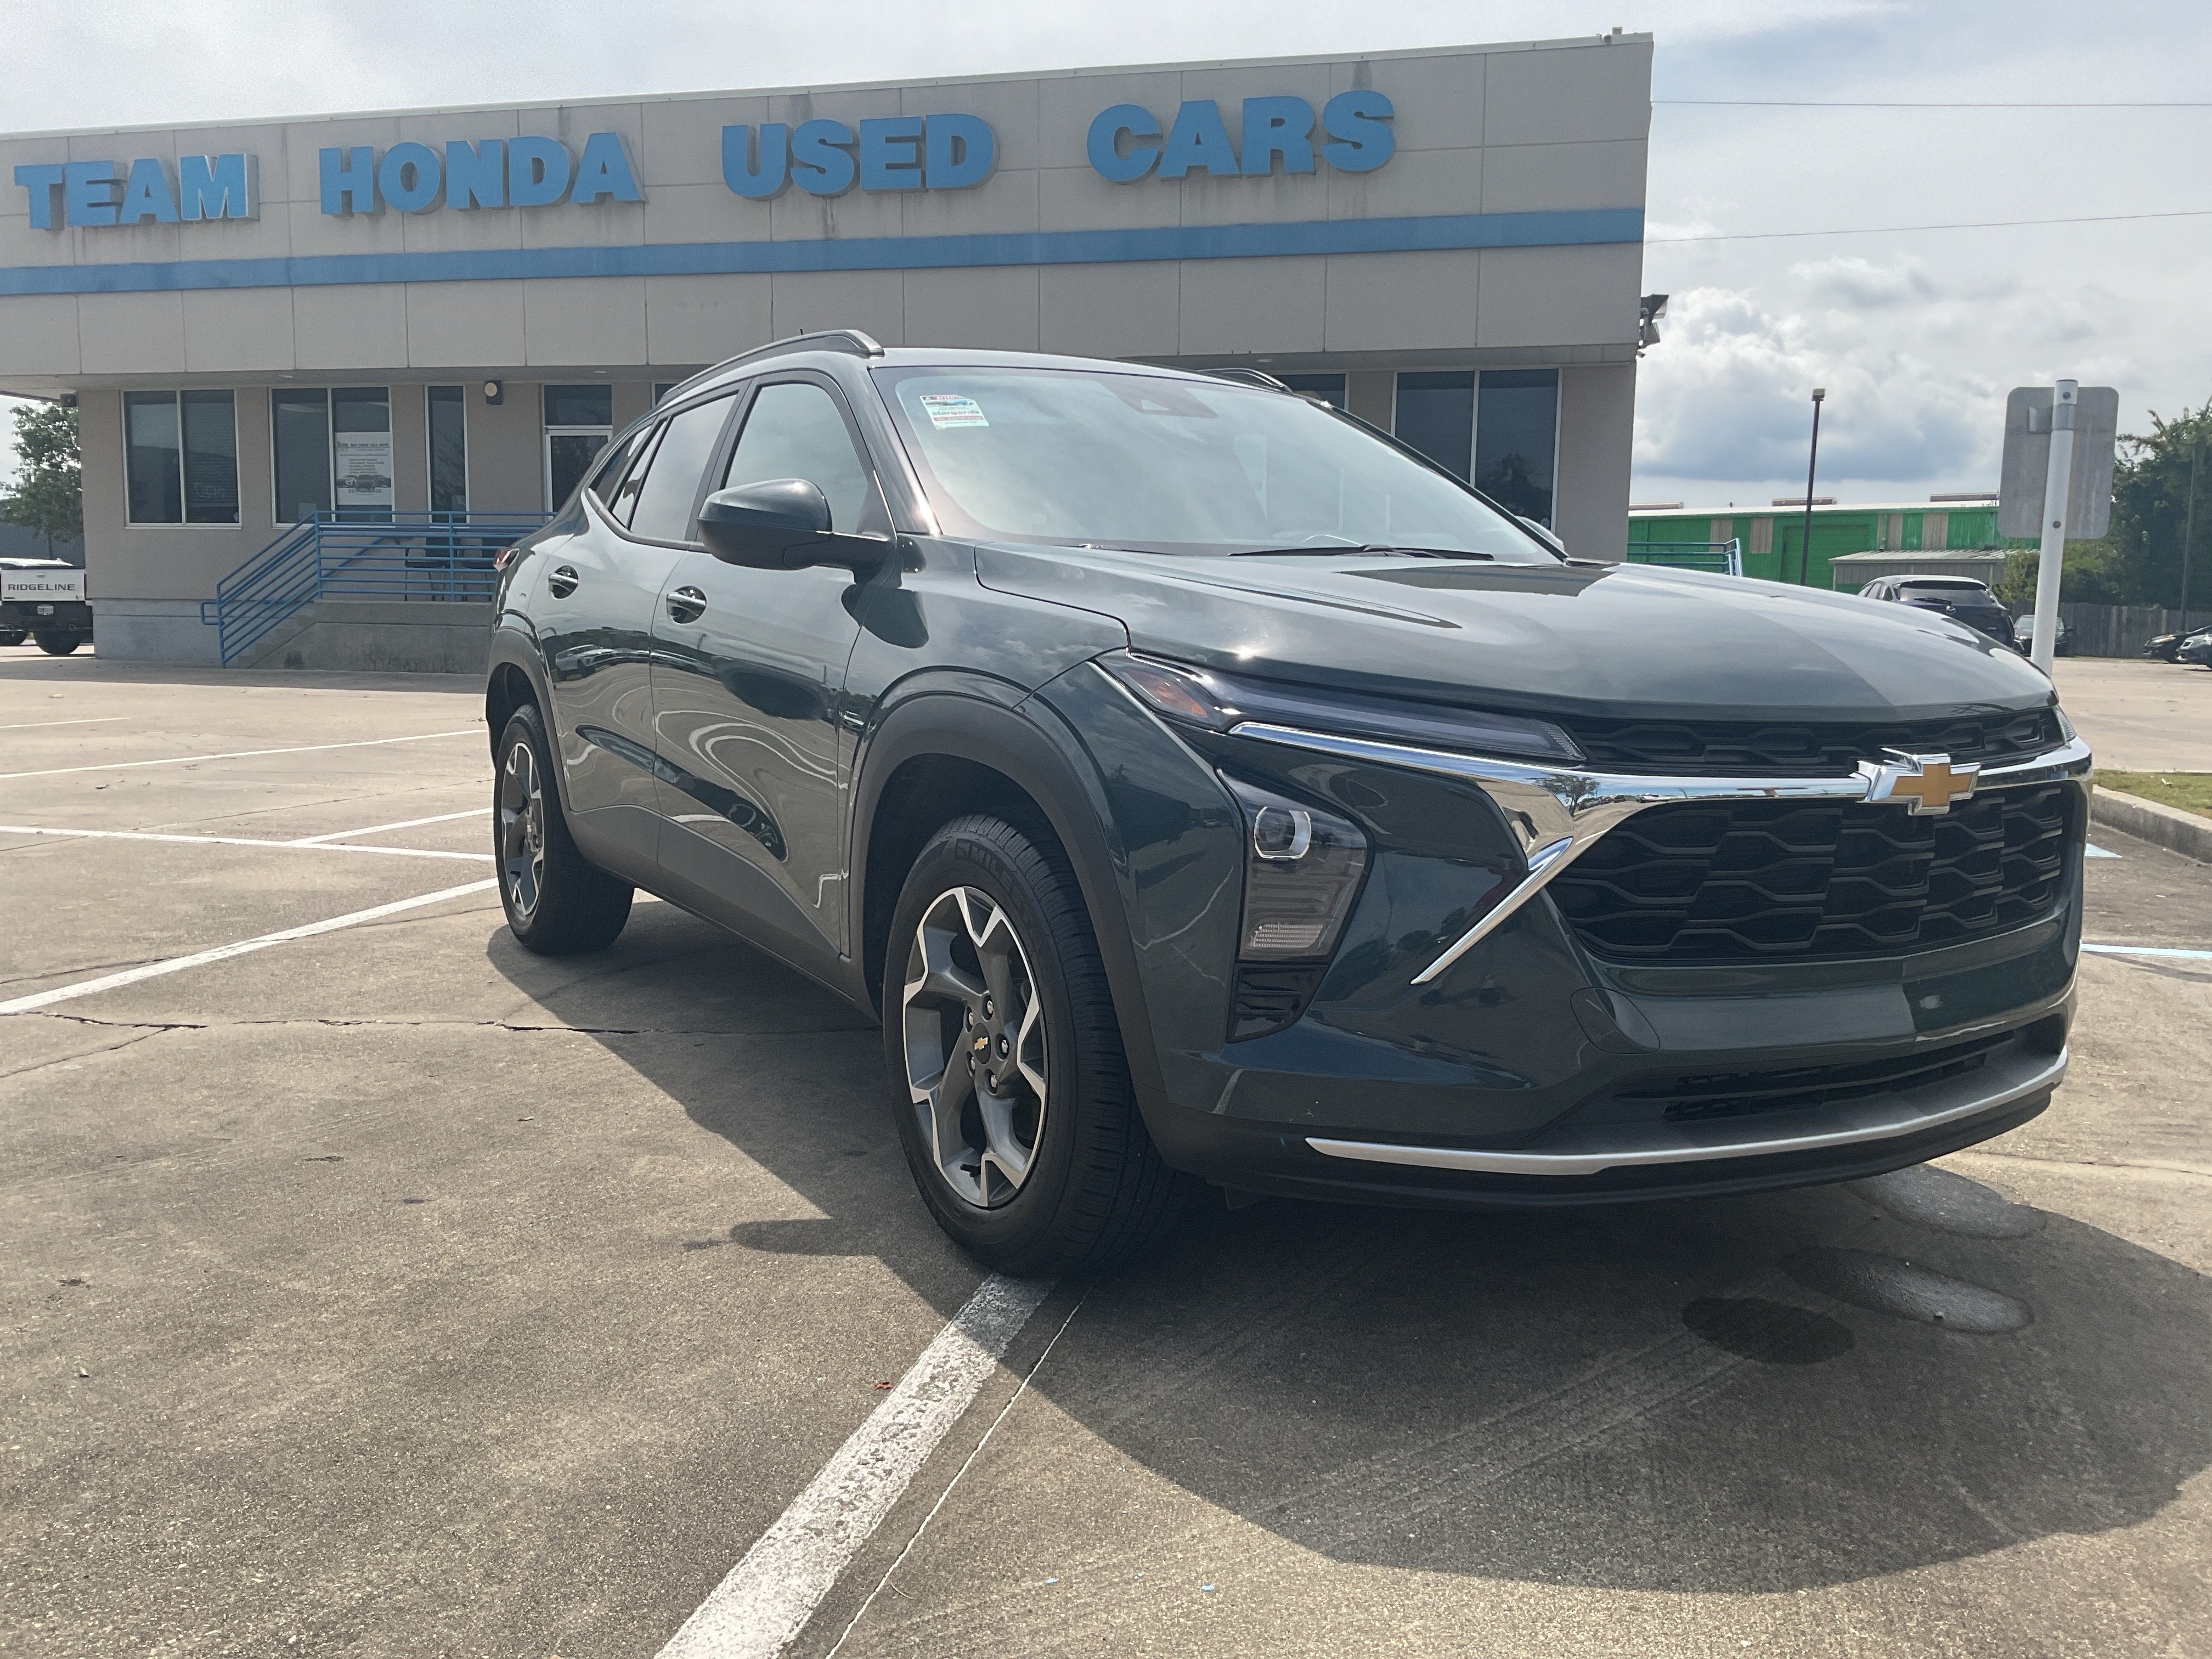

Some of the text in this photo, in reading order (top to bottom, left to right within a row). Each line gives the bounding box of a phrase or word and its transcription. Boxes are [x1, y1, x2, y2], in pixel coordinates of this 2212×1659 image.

[14, 89, 1396, 229] TEAM HONDA USED CARS
